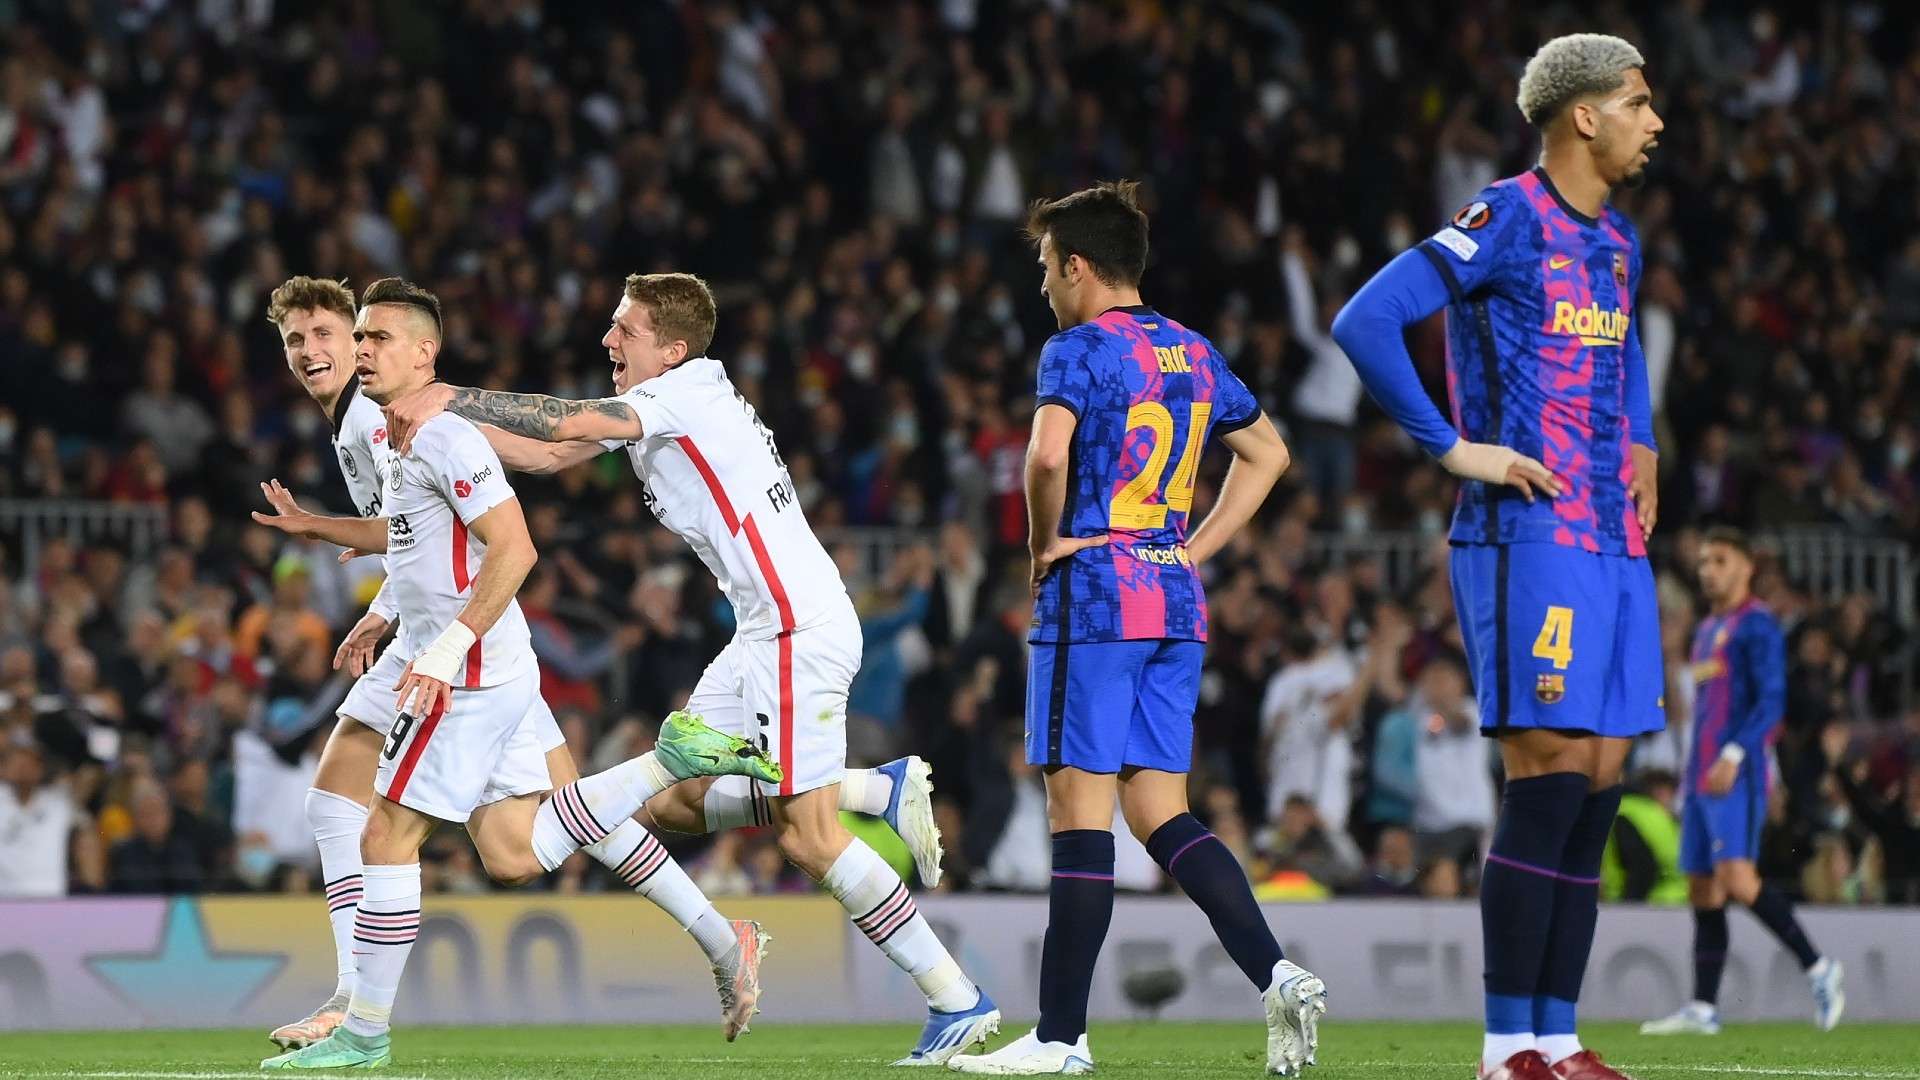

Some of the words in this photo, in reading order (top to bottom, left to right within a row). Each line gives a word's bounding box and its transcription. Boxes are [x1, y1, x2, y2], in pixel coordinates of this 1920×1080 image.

[1152, 345, 1192, 373] ERIC
[472, 465, 492, 484] dpd
[1108, 400, 1212, 531] 24
[1130, 544, 1178, 565] unicef
[1532, 605, 1574, 670] 4
[383, 711, 414, 761] 9
